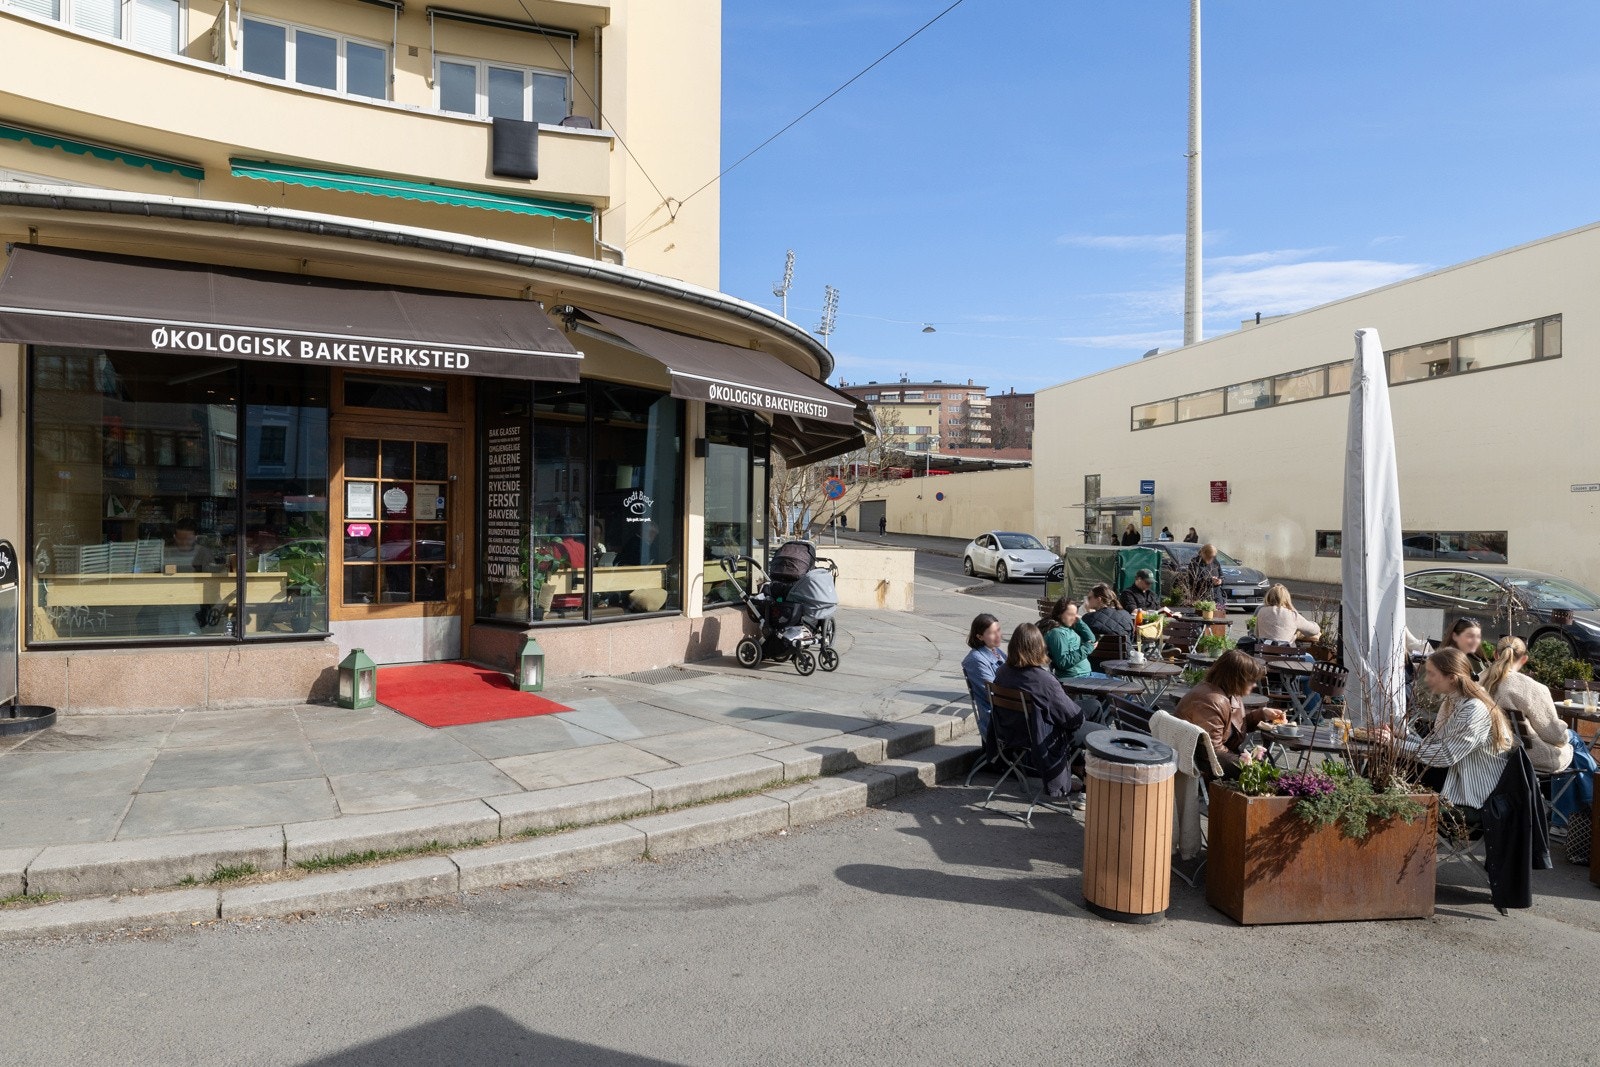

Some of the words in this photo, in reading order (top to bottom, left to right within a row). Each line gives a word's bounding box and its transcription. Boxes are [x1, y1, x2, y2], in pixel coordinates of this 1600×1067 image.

[151, 327, 292, 357] ØKOLOGISK
[300, 340, 470, 370] BAKEVERKSTED
[709, 383, 763, 407] ØKOLOGISK
[765, 395, 828, 418] BAKEVERKSTED
[488, 428, 499, 437] BAK
[500, 426, 520, 436] GLASSET
[488, 453, 520, 465] BAKERNE
[488, 480, 520, 492] RYKENDE
[488, 493, 520, 507] FERSKT
[488, 508, 520, 520] BAKVERK.
[488, 528, 520, 536] RUNDSTYKKER
[488, 544, 520, 556] ØKOLOGISK
[488, 562, 504, 576] KOM
[506, 564, 520, 577] INN
